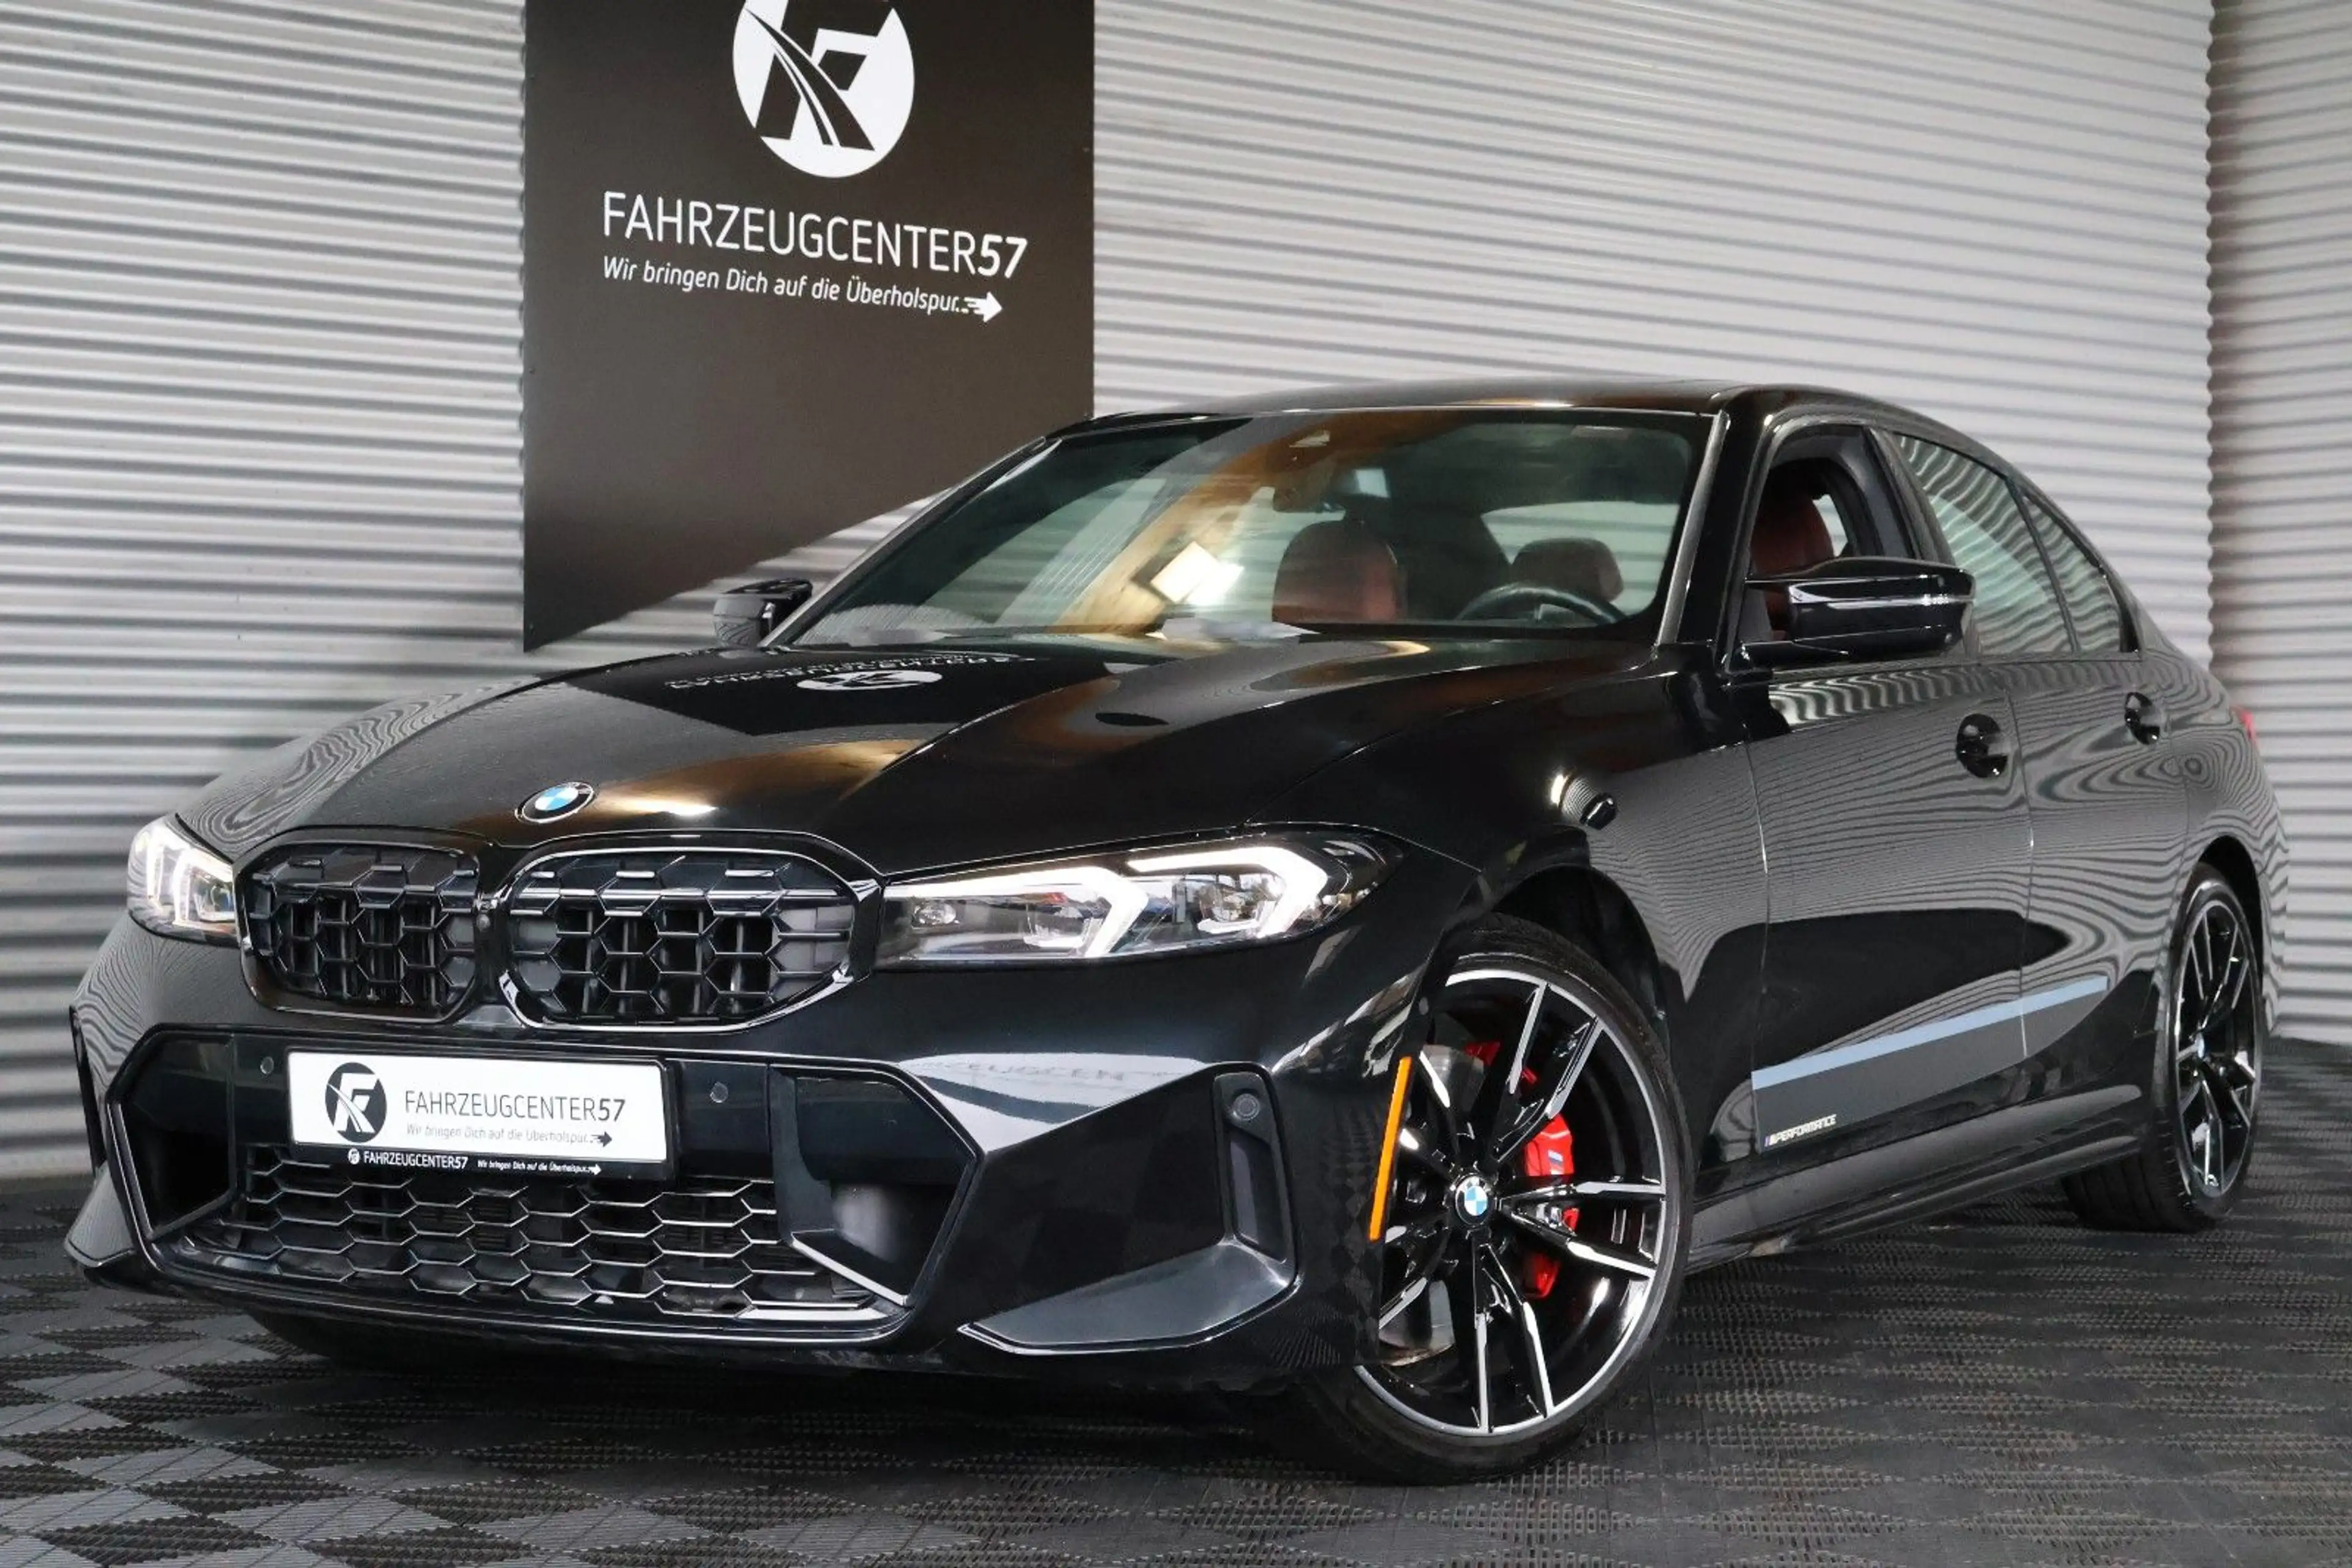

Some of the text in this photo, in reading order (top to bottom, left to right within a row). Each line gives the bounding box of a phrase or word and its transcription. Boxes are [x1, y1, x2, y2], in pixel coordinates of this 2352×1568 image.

[603, 190, 1028, 279] FAHRZEUGCENTER57
[603, 255, 638, 281] Wir
[643, 260, 720, 292] bringen
[726, 268, 768, 293] Dich
[774, 275, 808, 297] auf
[811, 277, 841, 301] die
[405, 1090, 625, 1122] FAHRZEUGCENTER57
[407, 1122, 421, 1136] Wir
[507, 1129, 522, 1140] die
[363, 1151, 469, 1169] FAHRZEUGCENTER57
